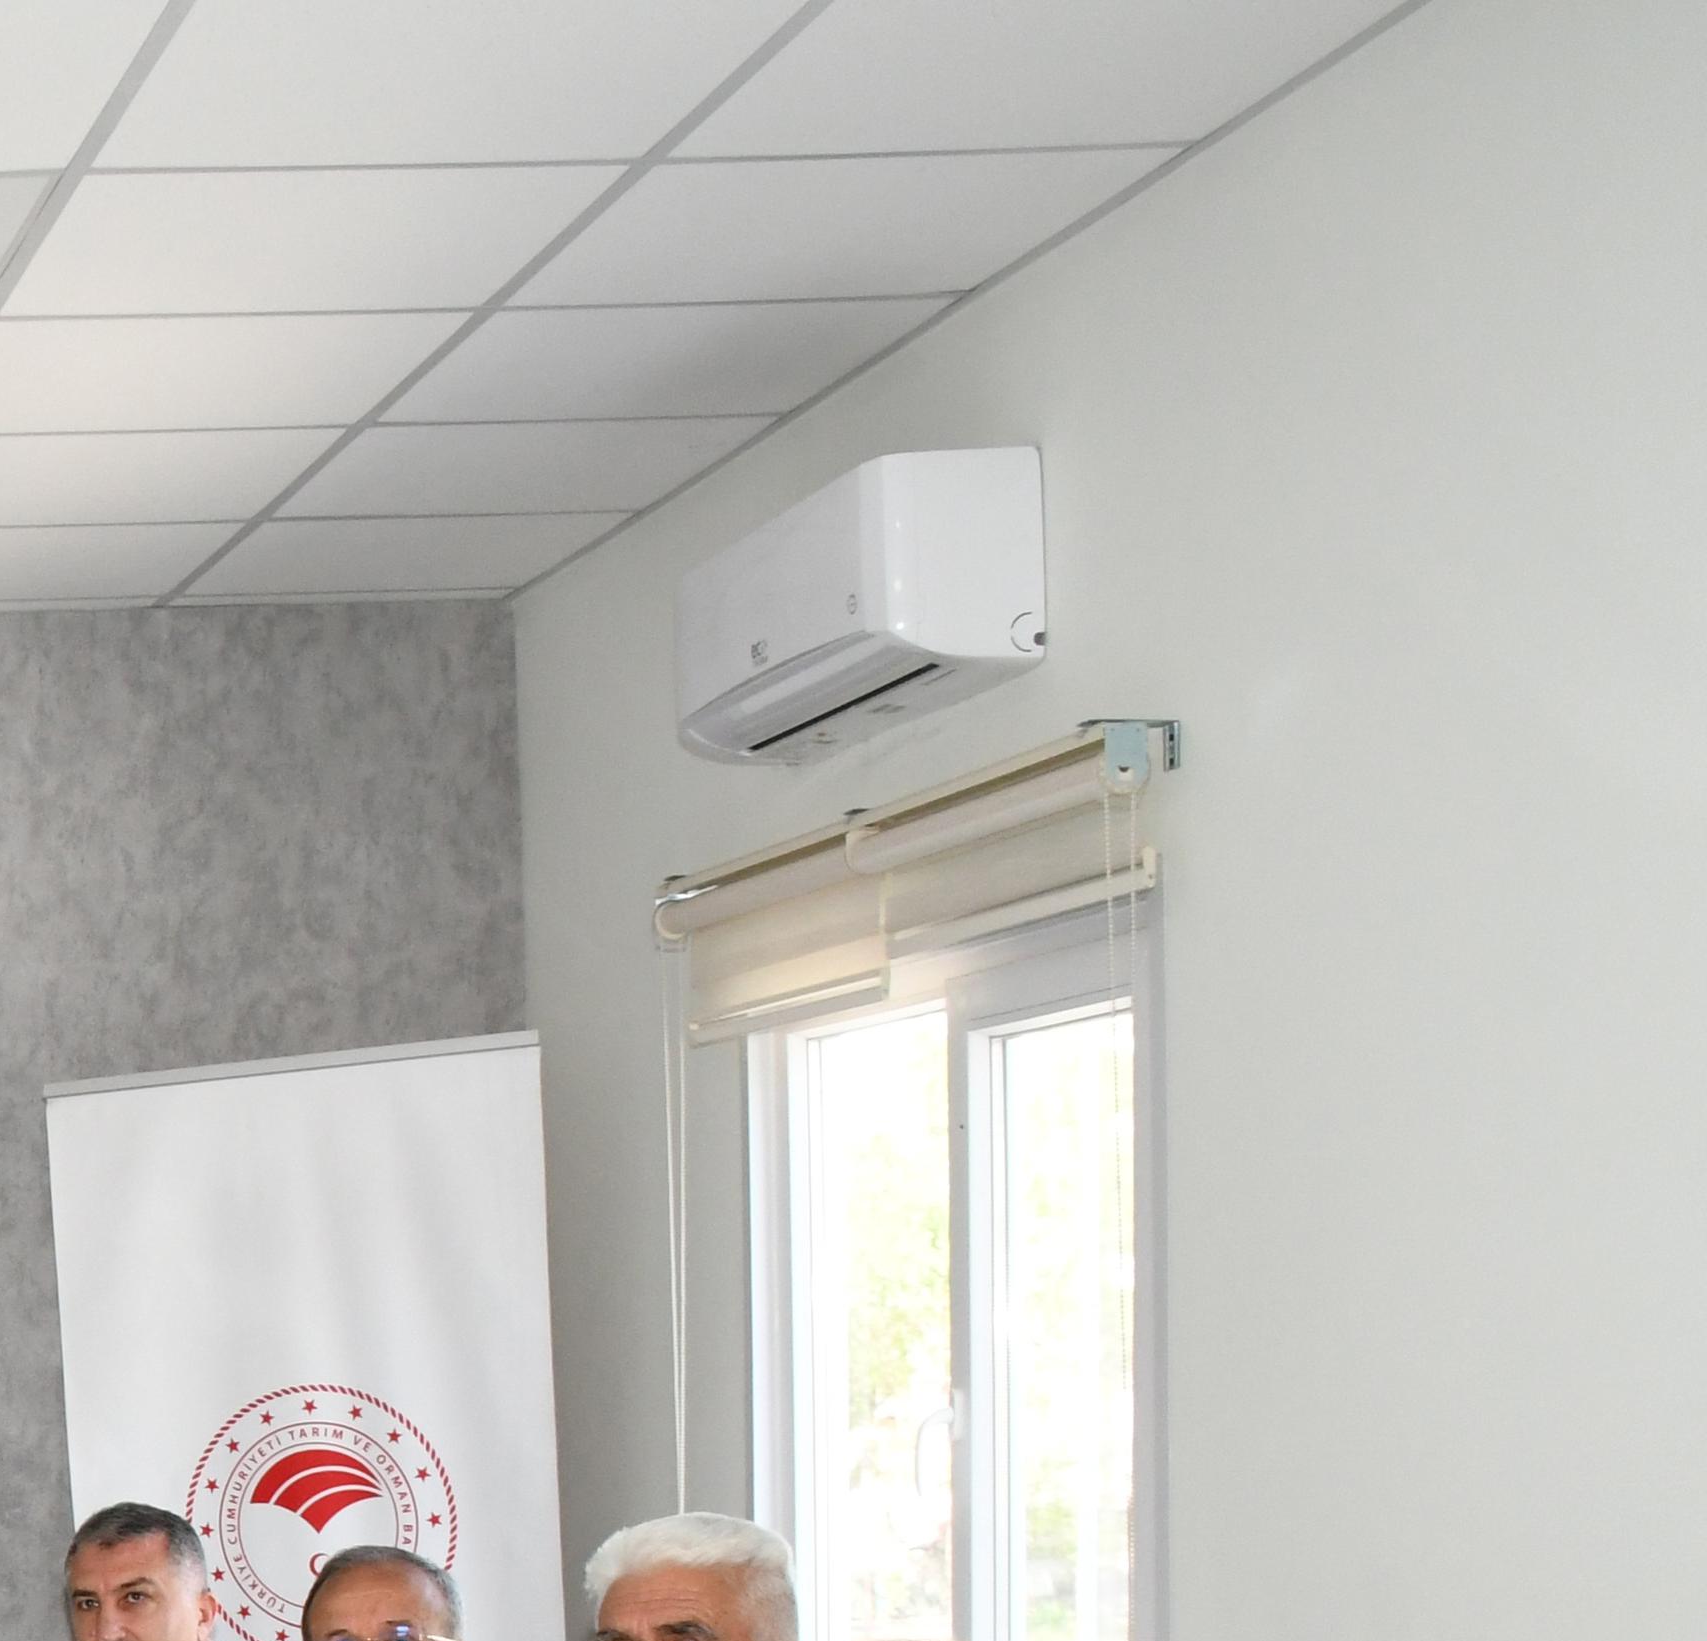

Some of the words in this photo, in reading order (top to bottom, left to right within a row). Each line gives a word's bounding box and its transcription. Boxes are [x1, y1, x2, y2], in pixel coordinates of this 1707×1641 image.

[287, 1426, 345, 1442] TARIM
[352, 1434, 373, 1454] VE
[225, 1435, 282, 1546] CUMHURİYETİ
[375, 1453, 413, 1515] ORMAN
[232, 1553, 286, 1615] TÜRKİYE
